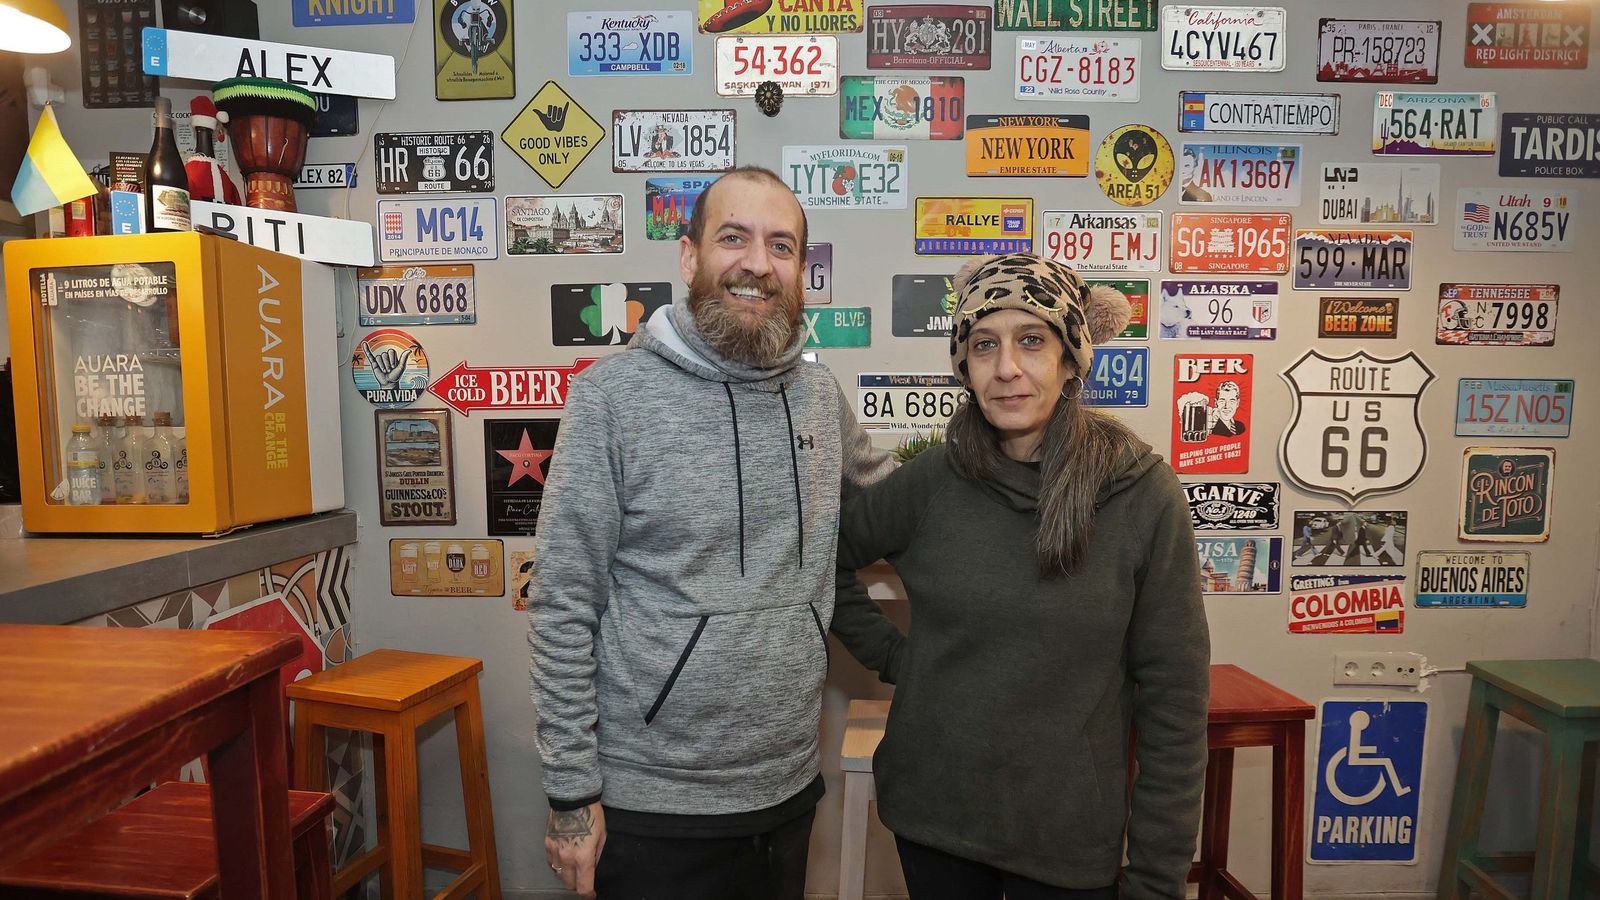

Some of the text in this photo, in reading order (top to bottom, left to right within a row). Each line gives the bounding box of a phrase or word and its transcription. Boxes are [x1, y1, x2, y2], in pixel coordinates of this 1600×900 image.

[998, 0, 1153, 28] WALL STREET
[1188, 11, 1263, 30] California
[1496, 8, 1563, 20] AMSTERDAM
[601, 17, 651, 30] Kentucky
[766, 14, 857, 31] Y NO LLORES
[872, 19, 986, 54] HY 281
[579, 32, 680, 61] 333 XDB
[1170, 30, 1277, 61] 4CYV467
[1332, 36, 1426, 64] PR-158723
[151, 56, 160, 67] E
[1476, 48, 1580, 60] RED LIGHT DISTRICT
[236, 47, 333, 88] ALEX
[1020, 55, 1136, 85] CGZ-8183
[1048, 87, 1063, 95] Wild
[1083, 88, 1107, 96] Country
[845, 95, 961, 121] MEX 1810
[1379, 94, 1393, 107] DEC
[1480, 99, 1490, 108] 05
[662, 113, 731, 123] NEVADA 05
[999, 117, 1059, 127] NEW YORK
[1209, 103, 1332, 126] CONTRATIEMPO
[1536, 115, 1588, 125] PUBLIC CALL
[401, 136, 432, 146] HISTORIC
[435, 135, 455, 146] ROUTE
[457, 135, 466, 145] 66
[519, 136, 588, 150] GOOD VIBES
[618, 124, 730, 157] LV 1854
[981, 137, 1075, 160] NEW YORK
[1212, 145, 1272, 155] ILLINOIS
[380, 145, 490, 182] HR 66
[538, 152, 570, 165] ONLY
[723, 159, 730, 167] 15
[1000, 166, 1057, 174] EMPIRE STATE
[1200, 158, 1295, 189] AK13687
[1535, 166, 1584, 175] POLICE BOX
[858, 164, 900, 193] E32
[1107, 184, 1160, 199] AREA 51
[808, 196, 882, 206] SUNSHINE STATE
[1322, 198, 1358, 219] DUBAI
[1499, 194, 1531, 208] Utah
[1543, 197, 1551, 207] 9
[511, 207, 550, 216] SANTIAGO
[416, 206, 484, 242] MC14
[945, 214, 999, 226] RALLYE
[1175, 216, 1183, 224] 19
[1279, 216, 1287, 225] 65
[1493, 211, 1569, 241] N685V
[1177, 227, 1286, 258] SG 1965
[1328, 233, 1382, 245] NEVADA
[1462, 231, 1488, 239] TRUST
[389, 246, 488, 257] PRINCIPAUTE DE MONACO
[1047, 231, 1158, 260] 989 EMJ
[404, 268, 425, 279] Ohio
[64, 275, 168, 289] 9 LITROS DE AGUA POTABLE
[1189, 284, 1250, 295] ALASKA
[365, 283, 467, 314] UDK 6868
[1469, 288, 1531, 299] TENNESSEE
[1208, 299, 1233, 324] 96
[1333, 300, 1388, 314] Welcome
[1476, 302, 1487, 313] N
[834, 311, 865, 327] BLVD
[1325, 315, 1393, 332] BEER ZONE
[1491, 302, 1549, 329] 7998
[257, 264, 285, 410] AUARA
[74, 353, 143, 374] AUARA
[1177, 358, 1248, 382] BEER
[74, 373, 145, 397] BE THE
[455, 374, 478, 388] ICE
[889, 375, 950, 387] West Virginia
[1330, 366, 1391, 391] ROUTE
[366, 390, 418, 402] PURA VIDA
[447, 388, 486, 401] COLD
[489, 370, 564, 406] BEER
[76, 397, 146, 418] CHANGE
[264, 412, 277, 469] CHANGE
[275, 412, 288, 468] BE THE
[1179, 442, 1241, 460] HELPING UGLY PEOPLE
[1321, 426, 1388, 478] 66
[72, 477, 96, 489] JUICE
[1471, 472, 1535, 505] RINCÓN
[72, 489, 91, 501] BAR
[391, 501, 444, 518] STOUT
[1205, 506, 1257, 519] No.1 1249
[1482, 507, 1500, 522] DE
[1497, 493, 1534, 528] TOTO
[1446, 555, 1503, 565] WELCOME TO
[1420, 567, 1525, 593] BUENOS AIRES
[1291, 586, 1404, 619] COLOMBIA
[1442, 596, 1496, 605] ARGENTINA
[1316, 815, 1412, 844] PARKING
